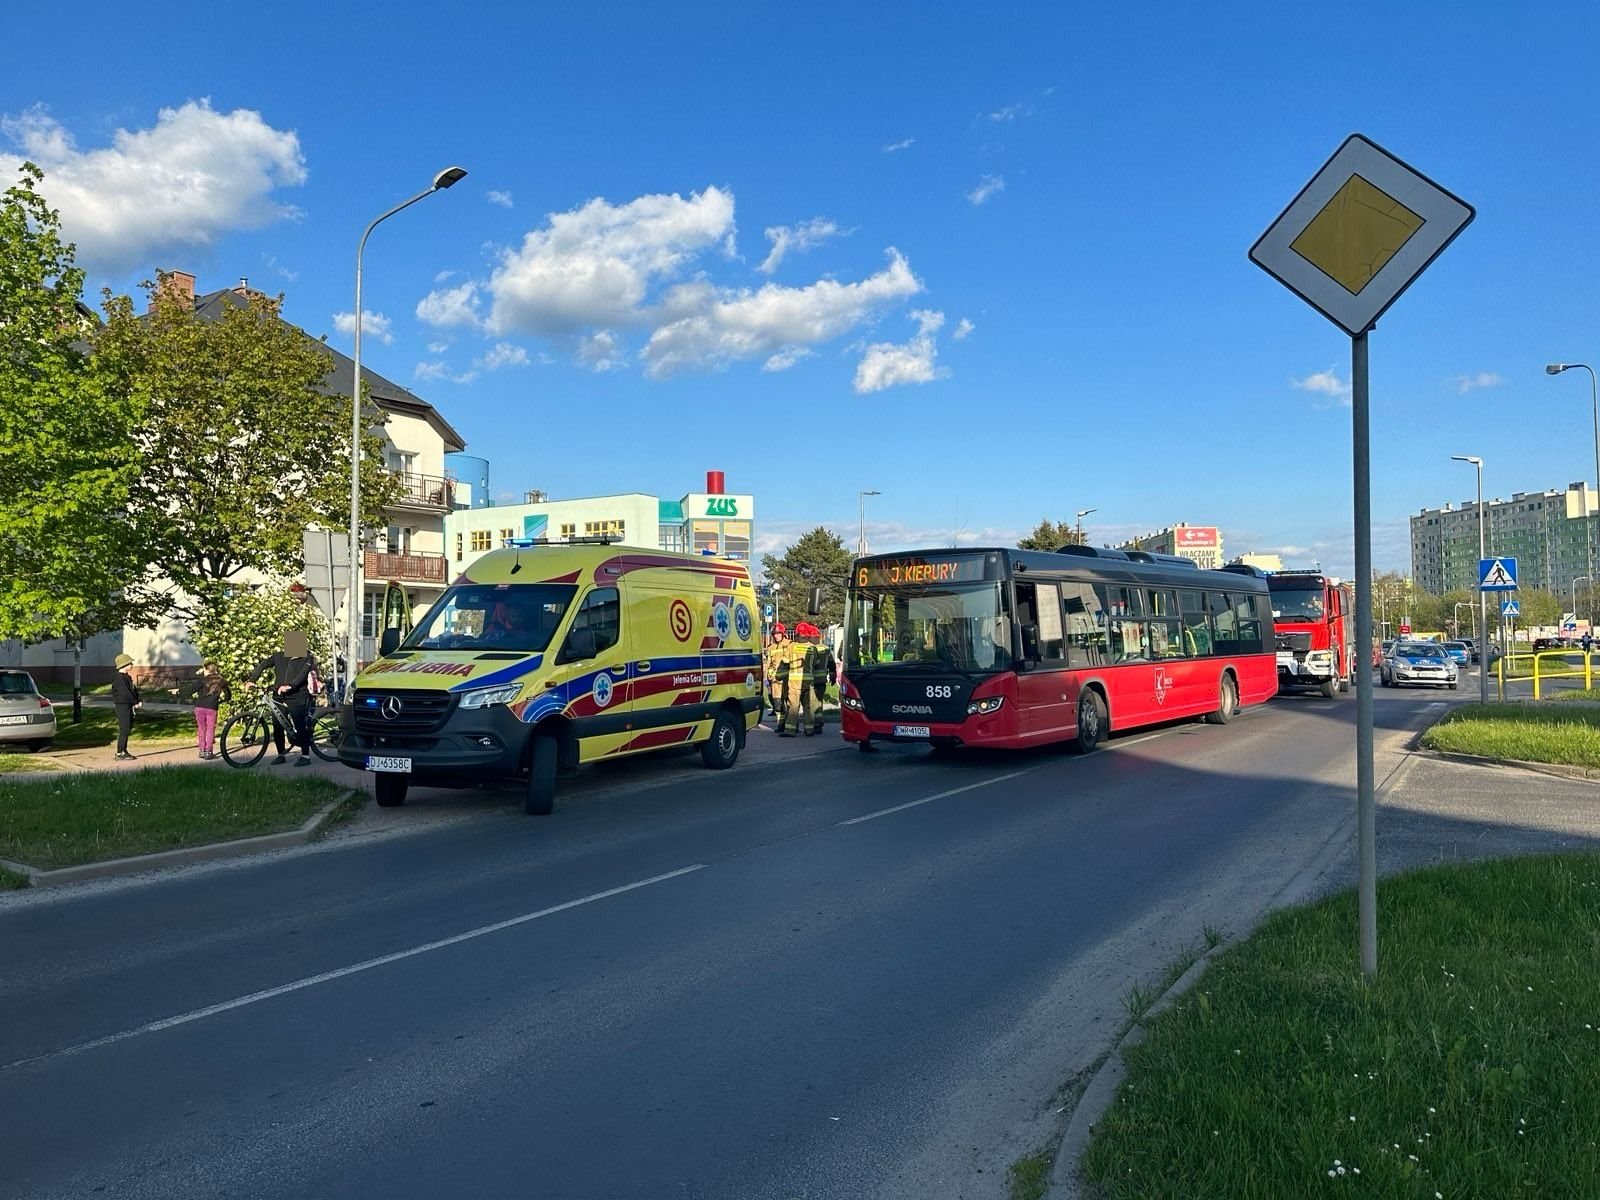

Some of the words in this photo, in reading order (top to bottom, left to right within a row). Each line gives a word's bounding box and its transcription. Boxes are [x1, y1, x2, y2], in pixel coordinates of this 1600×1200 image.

[705, 498, 738, 516] ZUS
[858, 567, 869, 587] 6
[905, 562, 958, 582] KIEPURY
[766, 605, 772, 616] P
[675, 608, 687, 635] S
[673, 674, 690, 686] Jelenia
[690, 673, 701, 683] Góra
[926, 685, 952, 698] 858
[891, 704, 933, 714] SCANIA
[370, 757, 381, 767] DJ
[382, 757, 410, 769] 6358C
